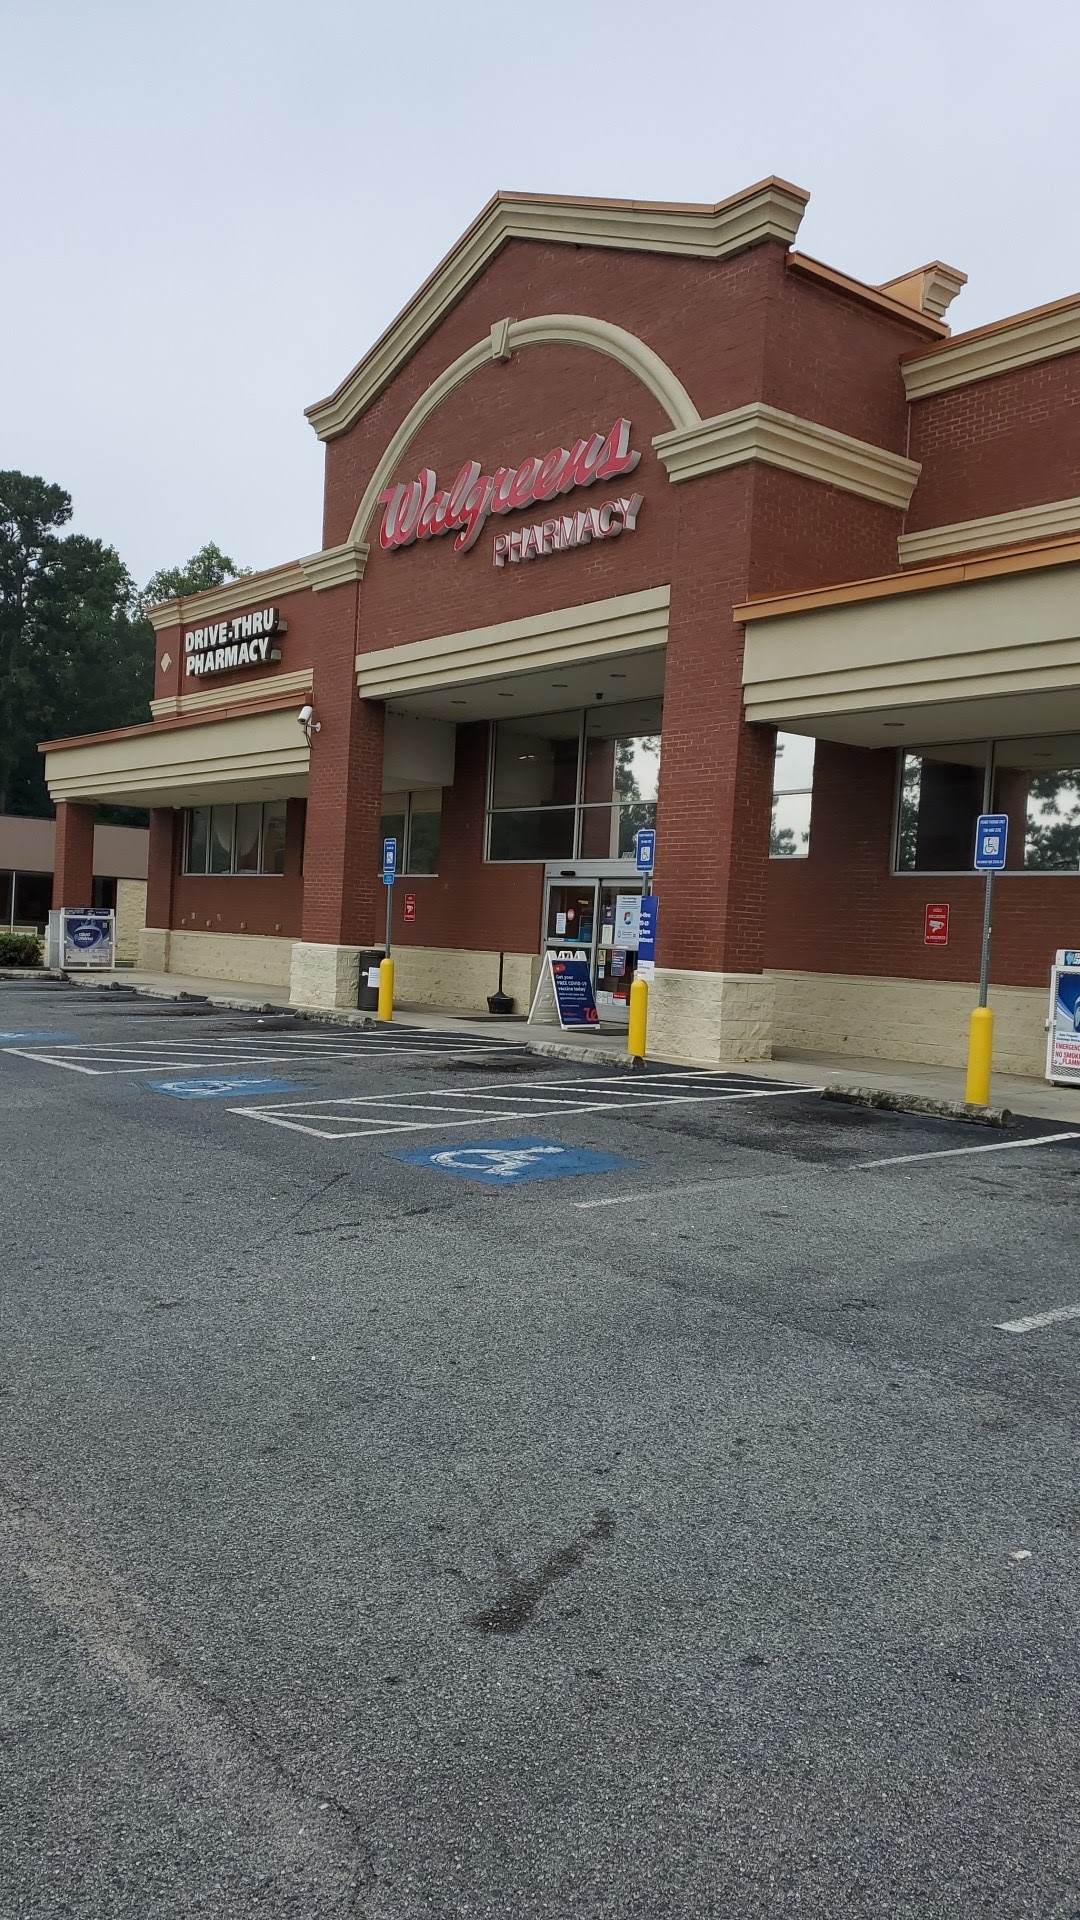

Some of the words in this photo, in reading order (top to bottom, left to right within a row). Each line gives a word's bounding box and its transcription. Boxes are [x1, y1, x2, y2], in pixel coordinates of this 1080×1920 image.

[377, 418, 641, 551] Walgreens
[493, 493, 644, 567] PHARMACY
[185, 607, 274, 653] DRIVE-THRU
[185, 637, 270, 676] PHARMACY
